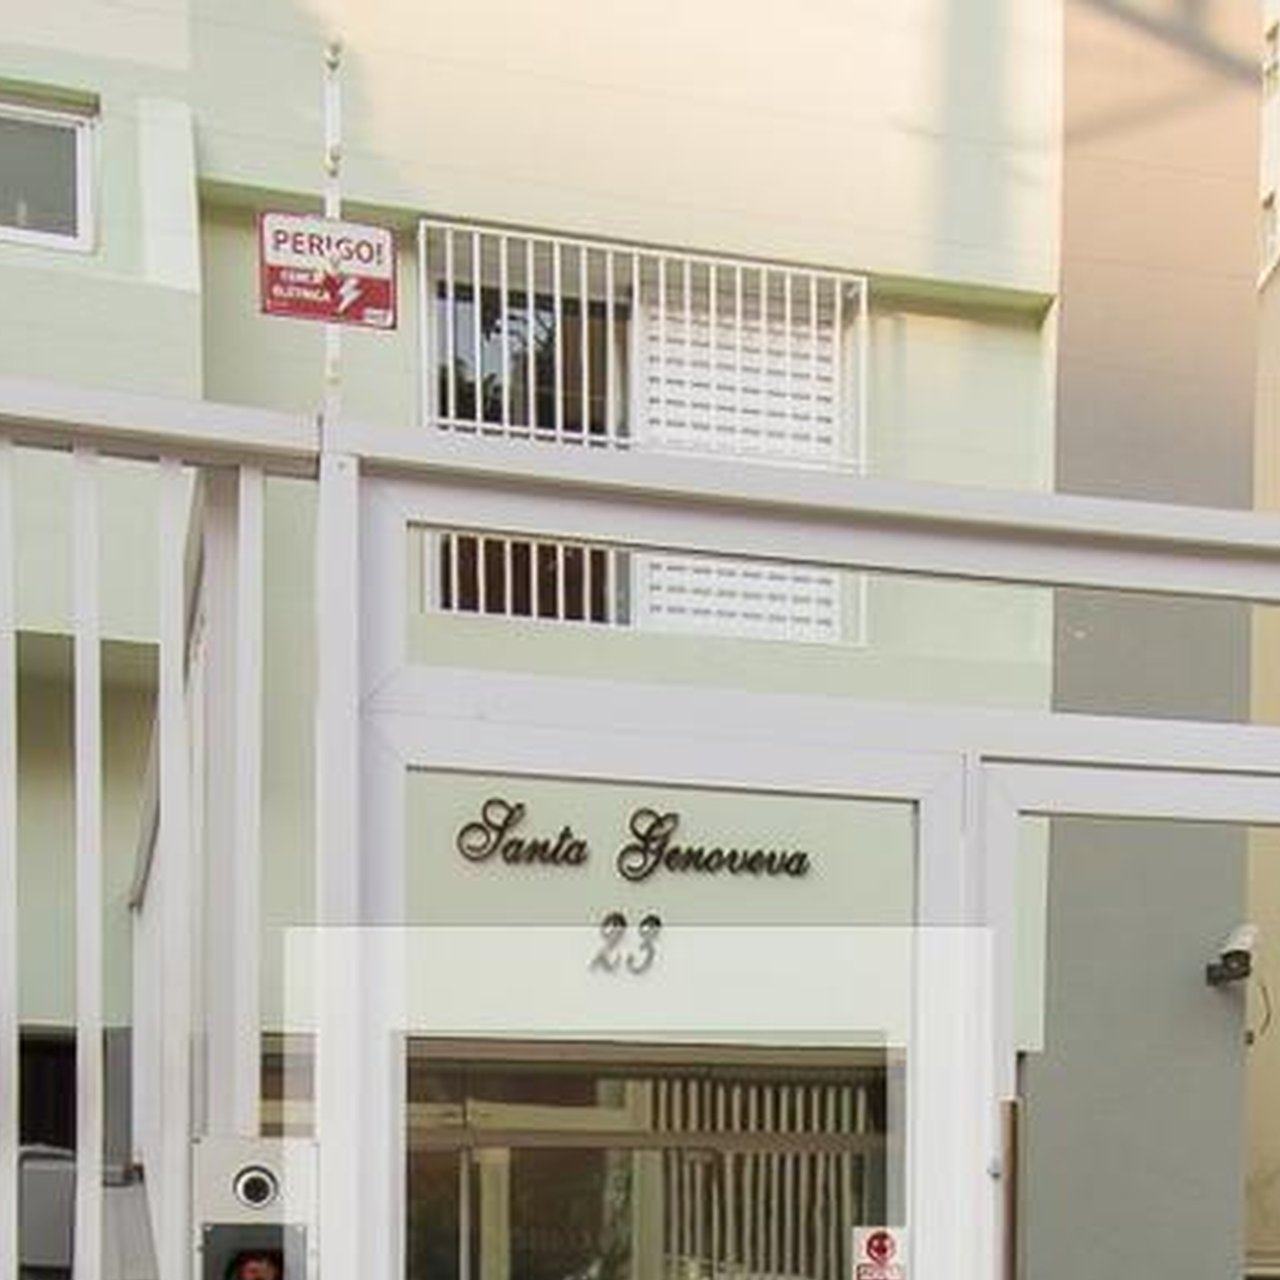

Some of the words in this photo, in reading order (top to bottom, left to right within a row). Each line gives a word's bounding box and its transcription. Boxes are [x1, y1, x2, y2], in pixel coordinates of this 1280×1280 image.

[273, 229, 383, 265] PERIGO!
[456, 797, 589, 868] Santa
[616, 808, 811, 882] Genoveva
[589, 910, 663, 975] 23
